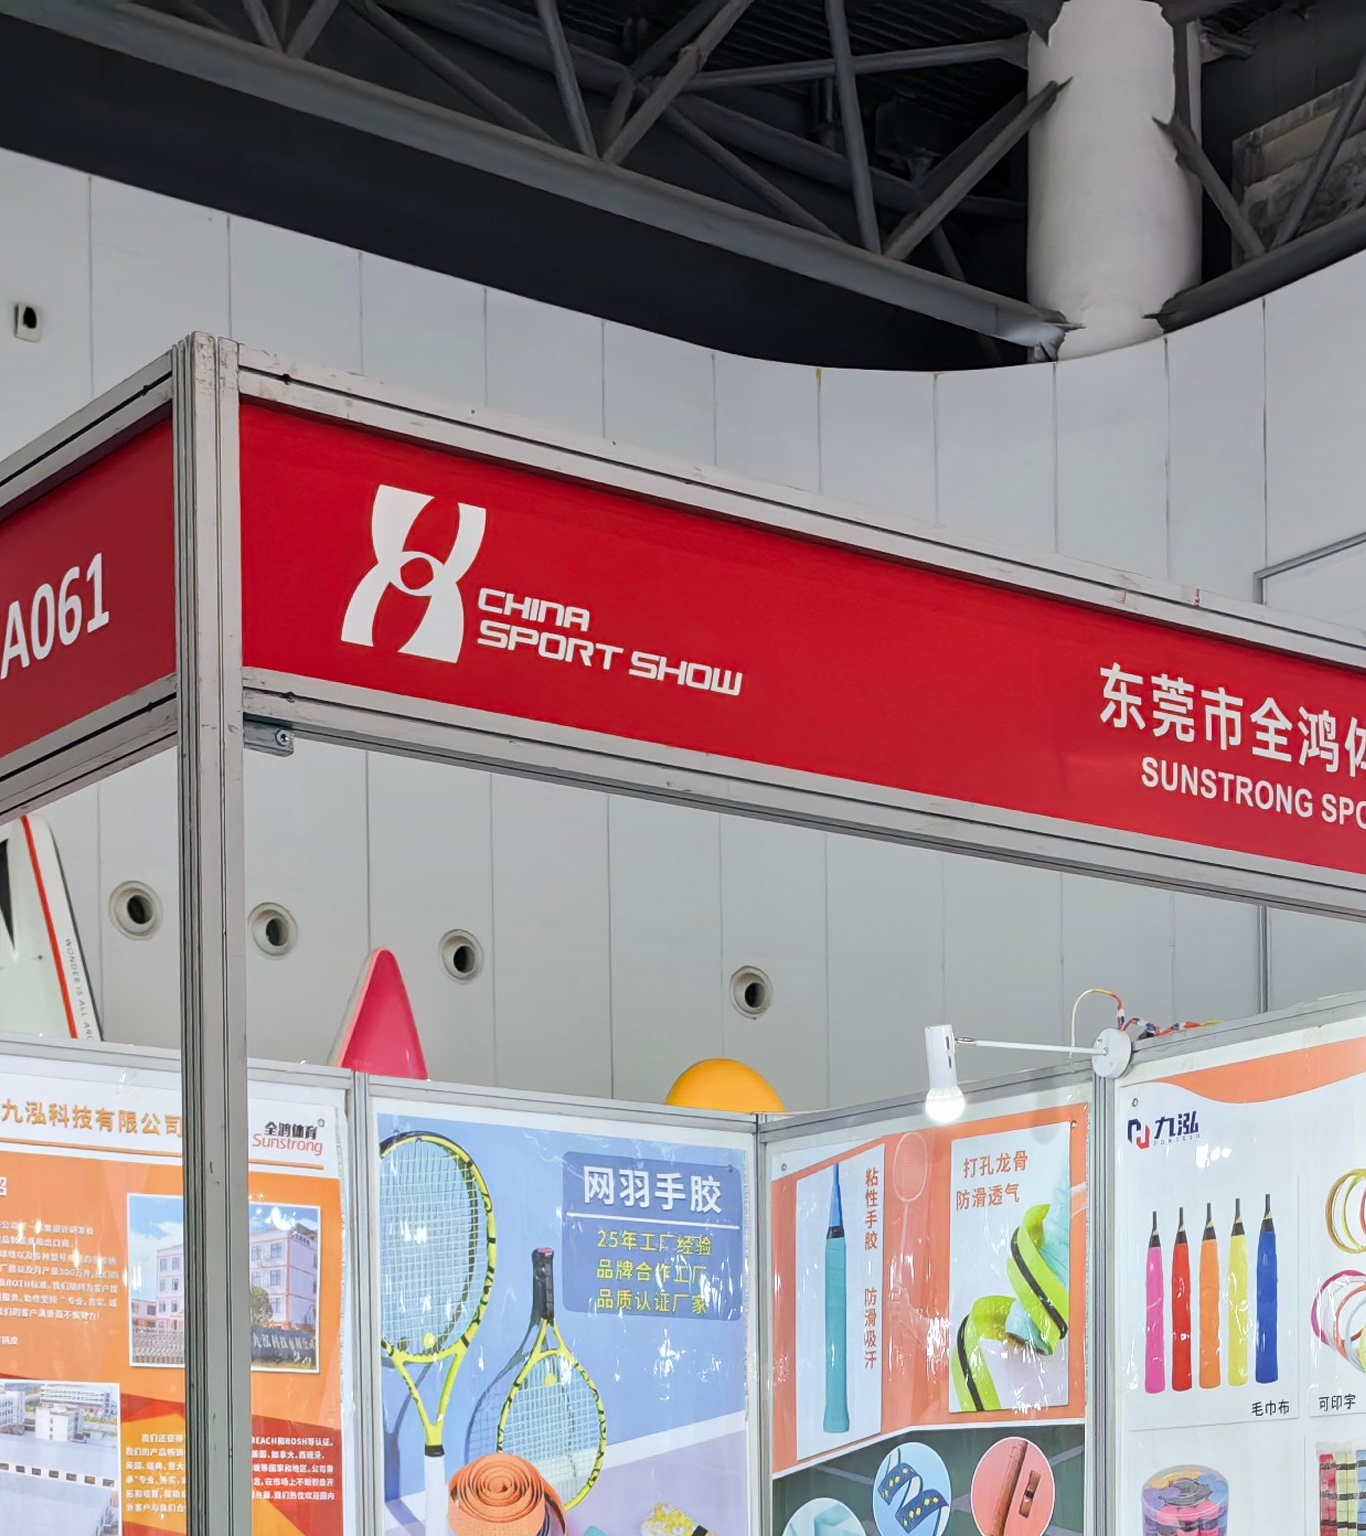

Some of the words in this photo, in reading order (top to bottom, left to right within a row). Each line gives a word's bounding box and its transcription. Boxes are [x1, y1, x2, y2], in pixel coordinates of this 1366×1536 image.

[478, 587, 590, 632] CHINA
[478, 620, 623, 672] SPORT
[629, 650, 743, 697] SHOW
[1140, 756, 1314, 819] SUNSTRONG
[265, 1121, 317, 1140] 全鸿体育
[1154, 1111, 1199, 1139] 九泓
[252, 1133, 323, 1156] Sunstrong
[963, 1150, 1028, 1178] 打孔龙骨
[583, 1165, 722, 1214] 网羽手胶
[956, 1183, 1020, 1211] 防滑透气
[865, 1167, 878, 1250] 粘性手胶
[597, 1229, 713, 1256] 25年工厂经验
[597, 1258, 707, 1284] 品牌合作工厂
[597, 1288, 707, 1315] 品质认证厂家
[864, 1288, 877, 1369] 防滑吸汗
[1252, 1400, 1290, 1417] 毛巾布
[1319, 1393, 1356, 1411] 可印字
